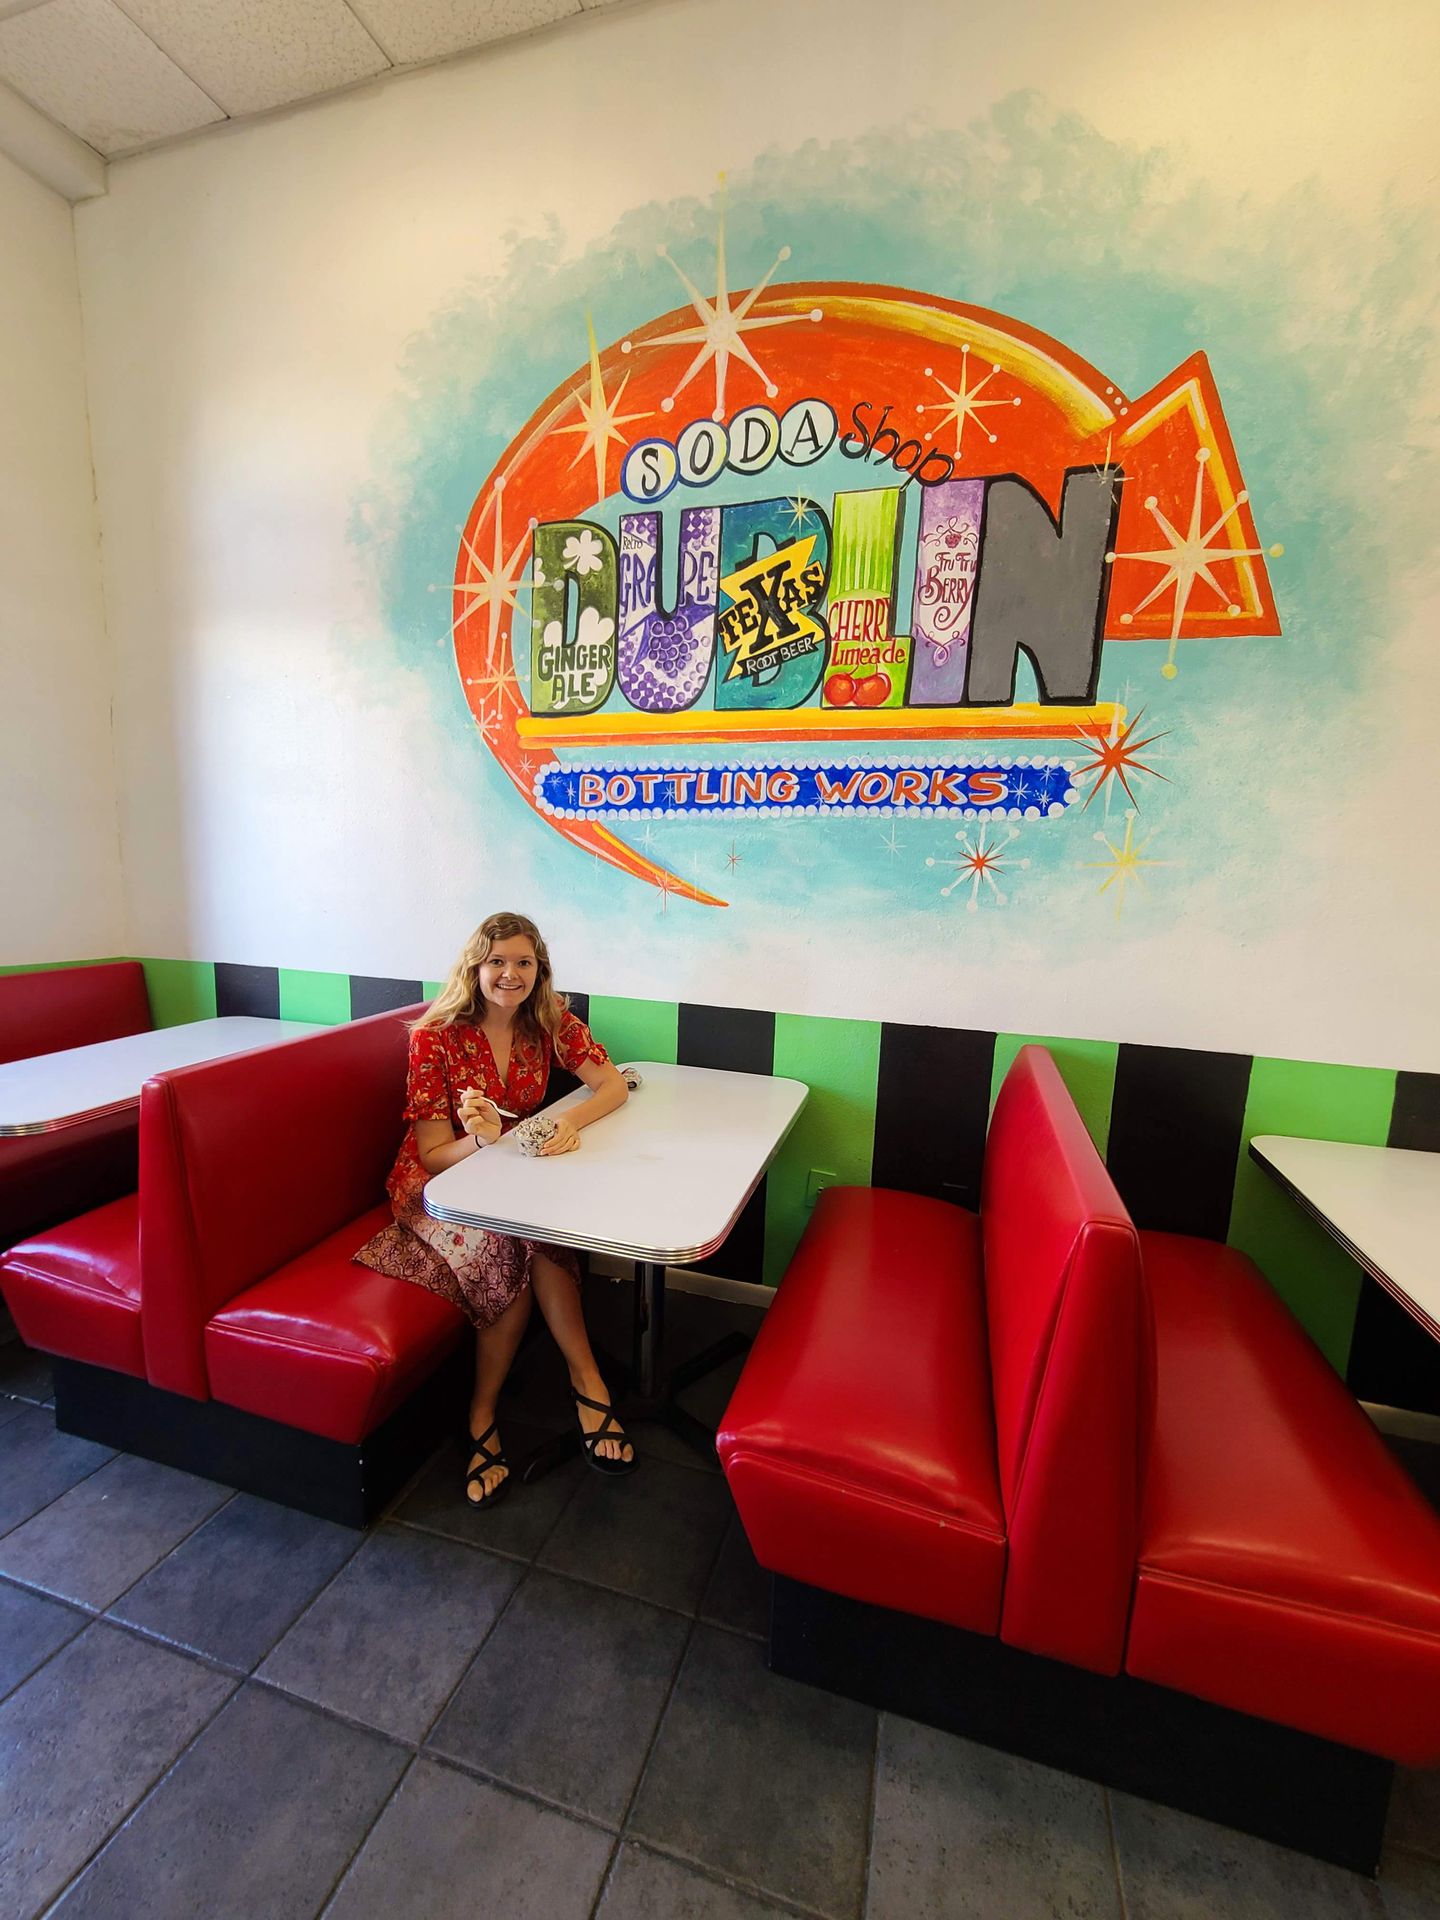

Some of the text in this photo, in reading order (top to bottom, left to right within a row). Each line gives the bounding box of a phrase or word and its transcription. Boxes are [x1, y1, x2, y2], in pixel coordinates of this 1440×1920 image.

[640, 401, 956, 498] SODA Shop
[530, 463, 1126, 717] DUBLIN
[719, 560, 822, 656] TEXAS
[538, 643, 612, 682] GINGER
[746, 637, 813, 675] ROOT BEER
[831, 638, 906, 666] Limeade
[551, 672, 595, 702] ALE
[579, 769, 1010, 808] BOTTLING WORKS
